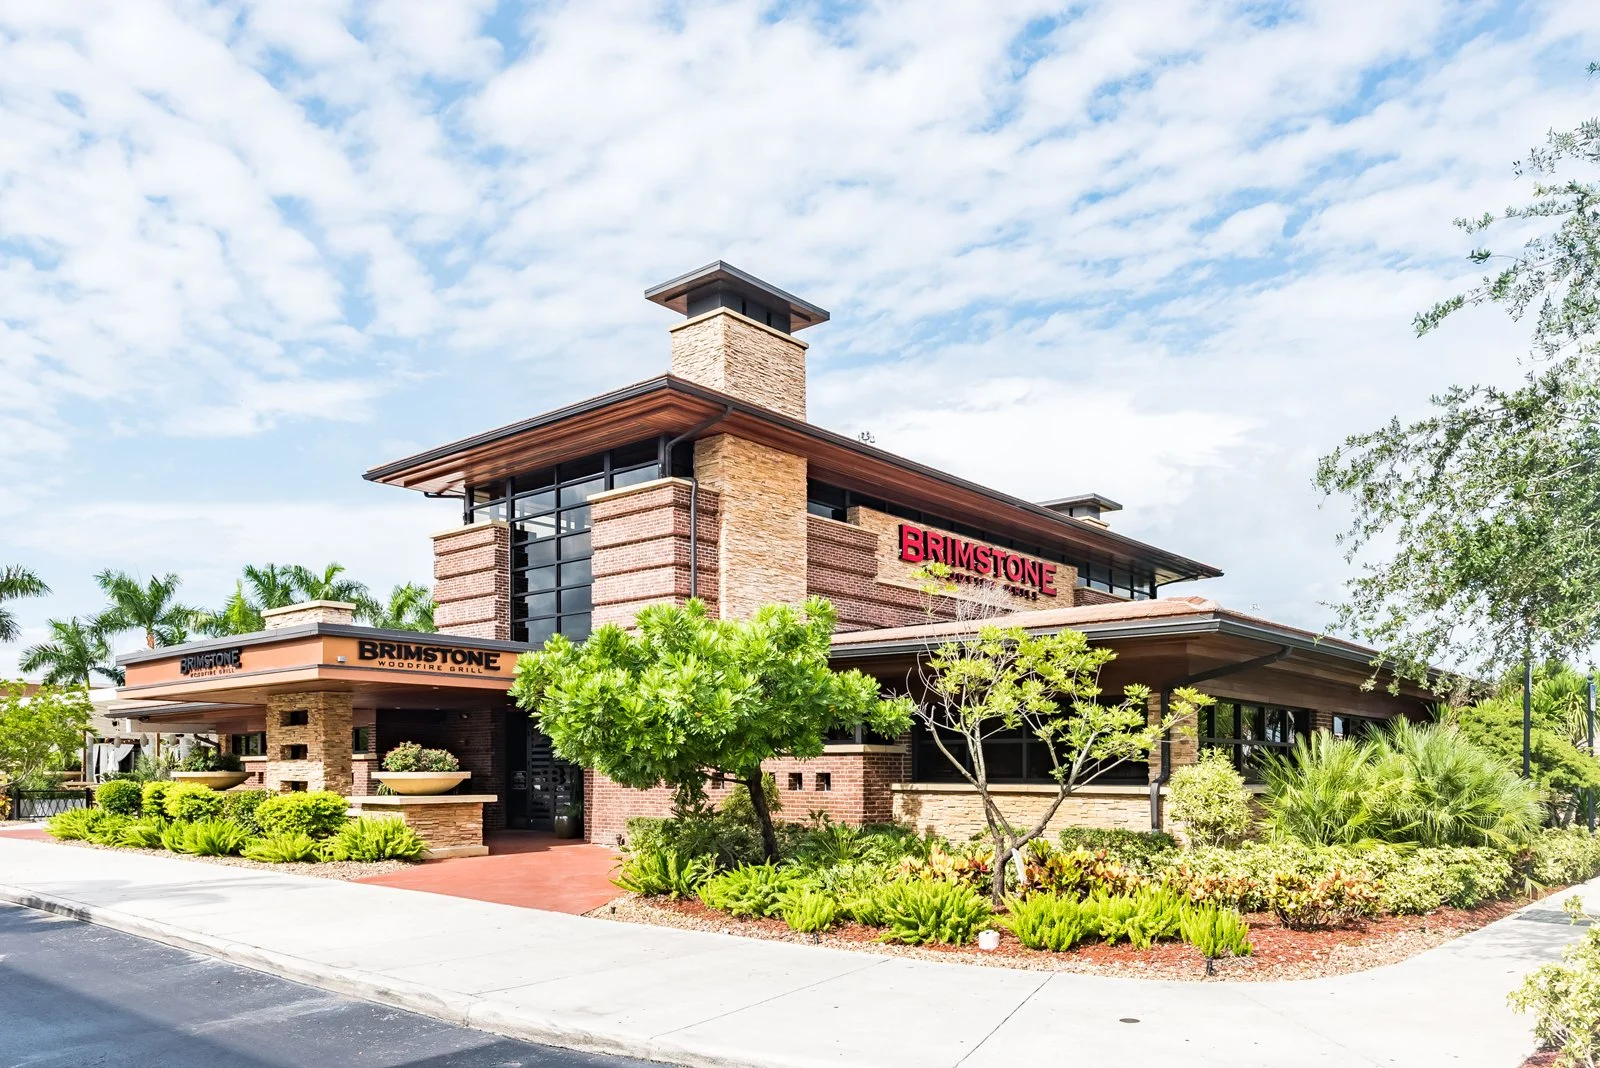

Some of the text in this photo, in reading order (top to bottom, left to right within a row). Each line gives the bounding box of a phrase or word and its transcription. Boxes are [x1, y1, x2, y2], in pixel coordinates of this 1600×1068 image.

[899, 524, 1057, 596] BRIMSTONE
[180, 648, 242, 676] BRIMSTONE
[358, 640, 501, 671] BRIMSTONE
[378, 660, 483, 674] WOODFIRE GRILL
